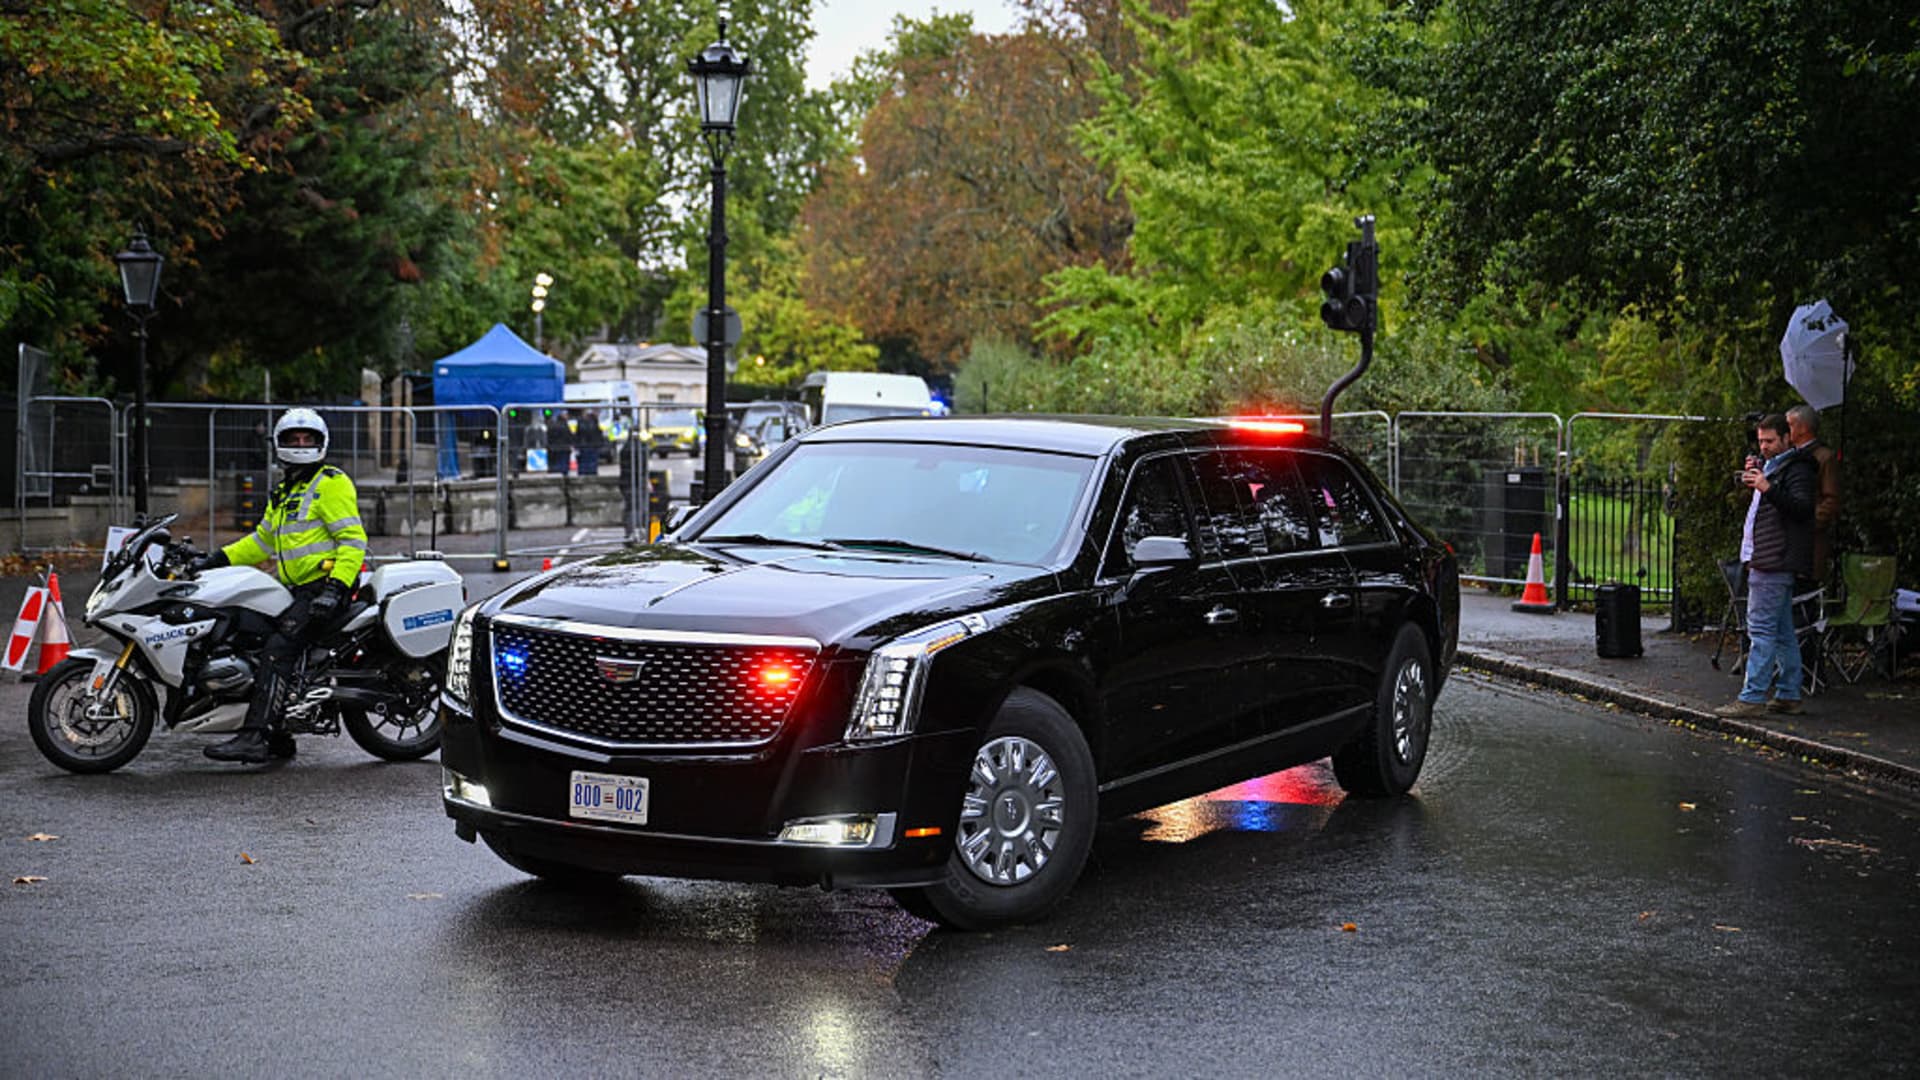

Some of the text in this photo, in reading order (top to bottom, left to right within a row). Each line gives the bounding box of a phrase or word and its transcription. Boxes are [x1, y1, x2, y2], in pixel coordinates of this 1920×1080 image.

[145, 628, 185, 643] POLICE
[575, 783, 642, 812] 800 002
